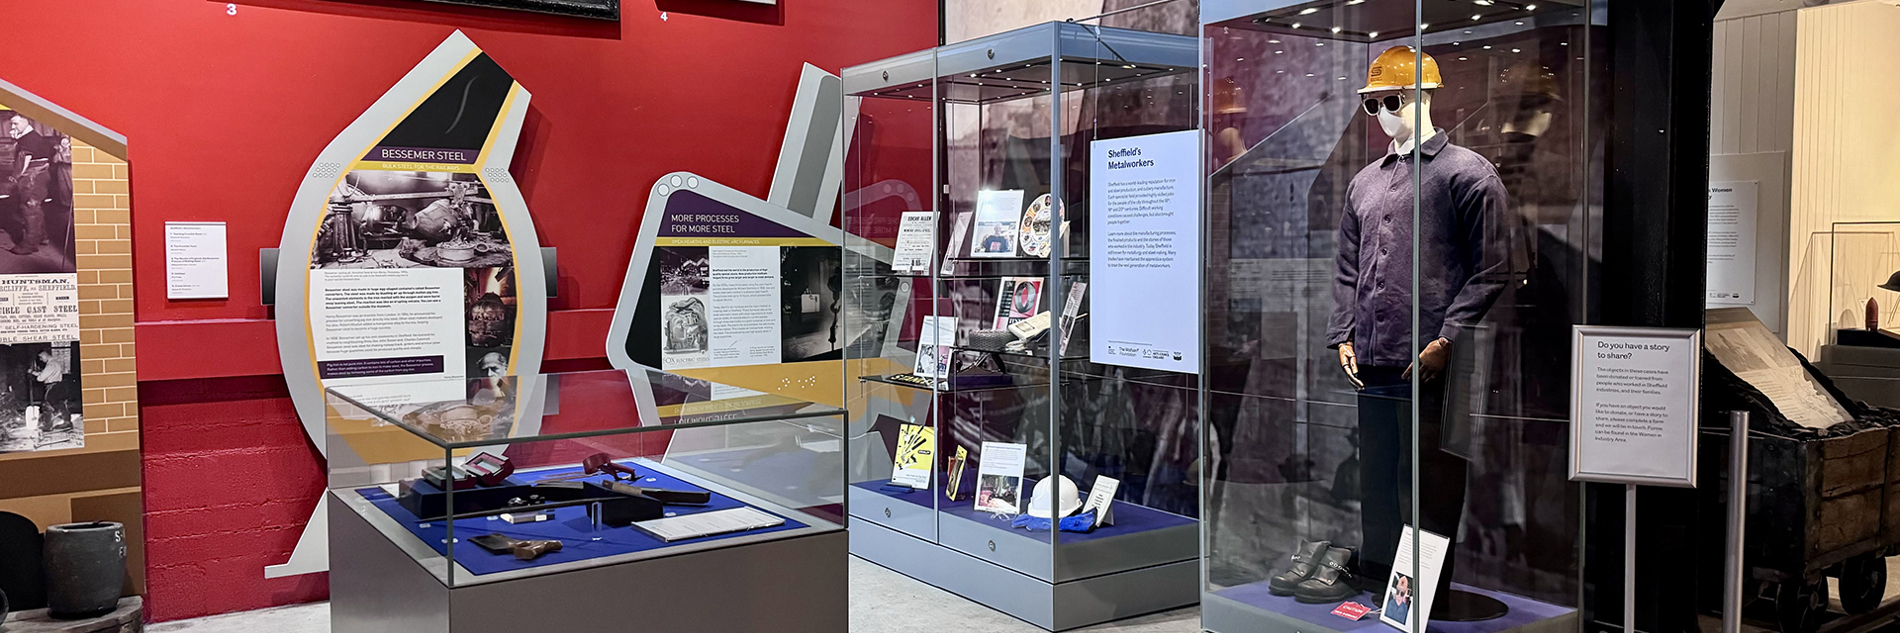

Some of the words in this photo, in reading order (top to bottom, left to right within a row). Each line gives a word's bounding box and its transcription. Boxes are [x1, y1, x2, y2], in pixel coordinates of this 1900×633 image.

[227, 3, 237, 15] 3
[660, 11, 668, 22] 4
[382, 149, 435, 160] BESSEMER
[437, 151, 466, 160] STEEL
[1108, 148, 1142, 158] Sheffield's
[1108, 159, 1154, 169] Metalworkers
[1650, 343, 1670, 352] story
